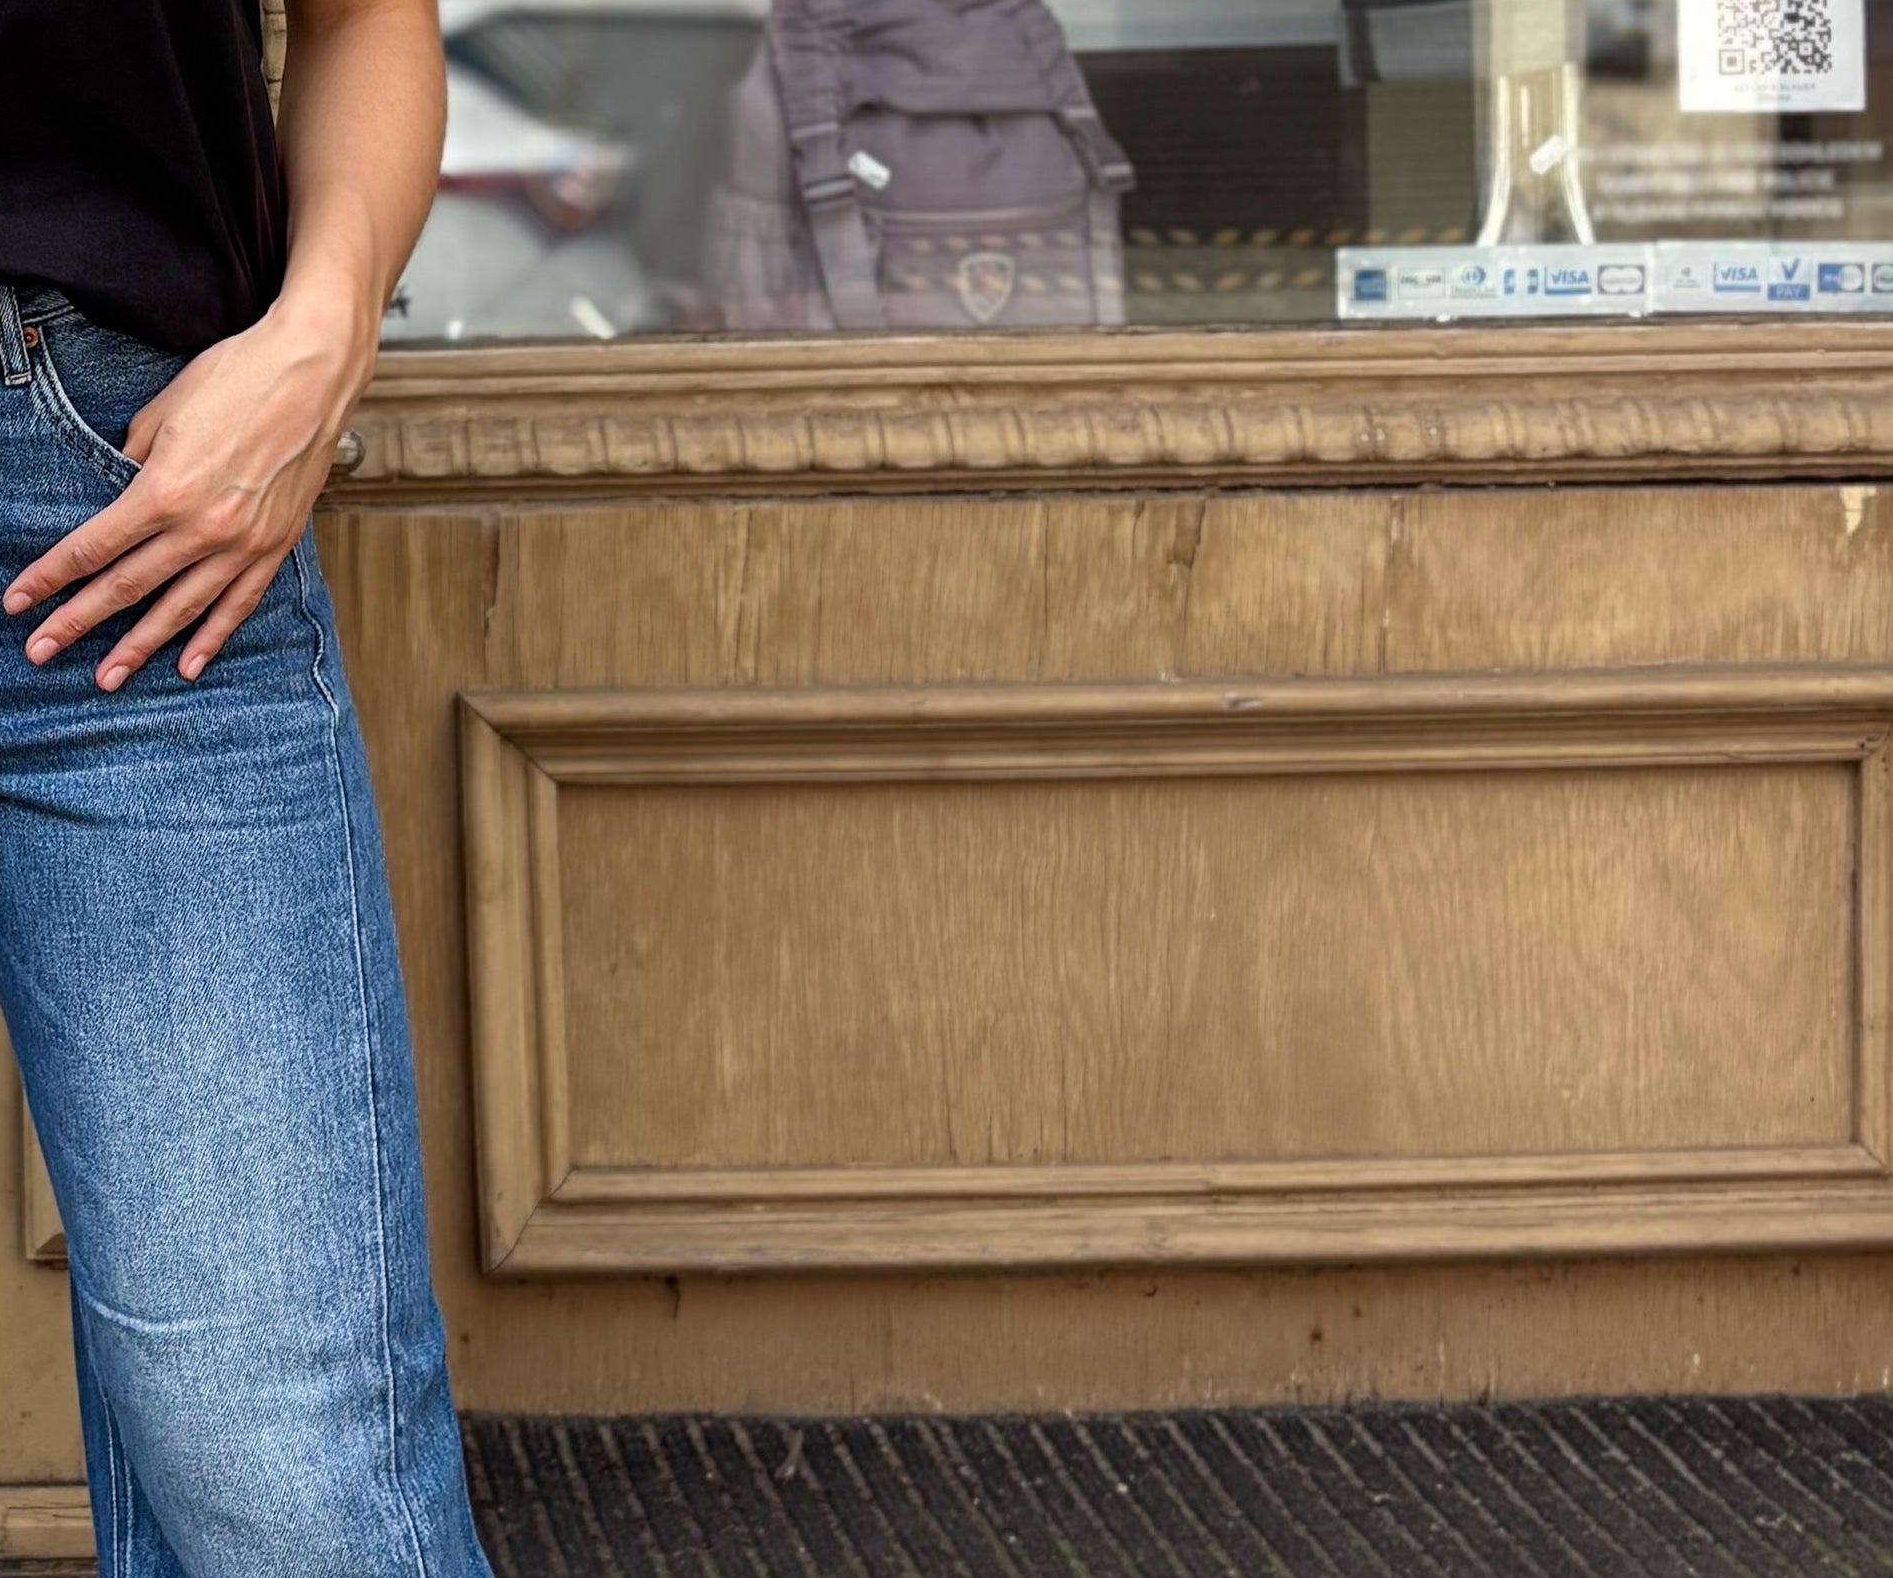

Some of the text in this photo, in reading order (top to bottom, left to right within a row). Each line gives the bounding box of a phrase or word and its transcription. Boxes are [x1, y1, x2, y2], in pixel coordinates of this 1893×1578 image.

[1550, 269, 1590, 286] VISA
[1720, 266, 1758, 282] VISA
[1776, 285, 1802, 298] PAY
